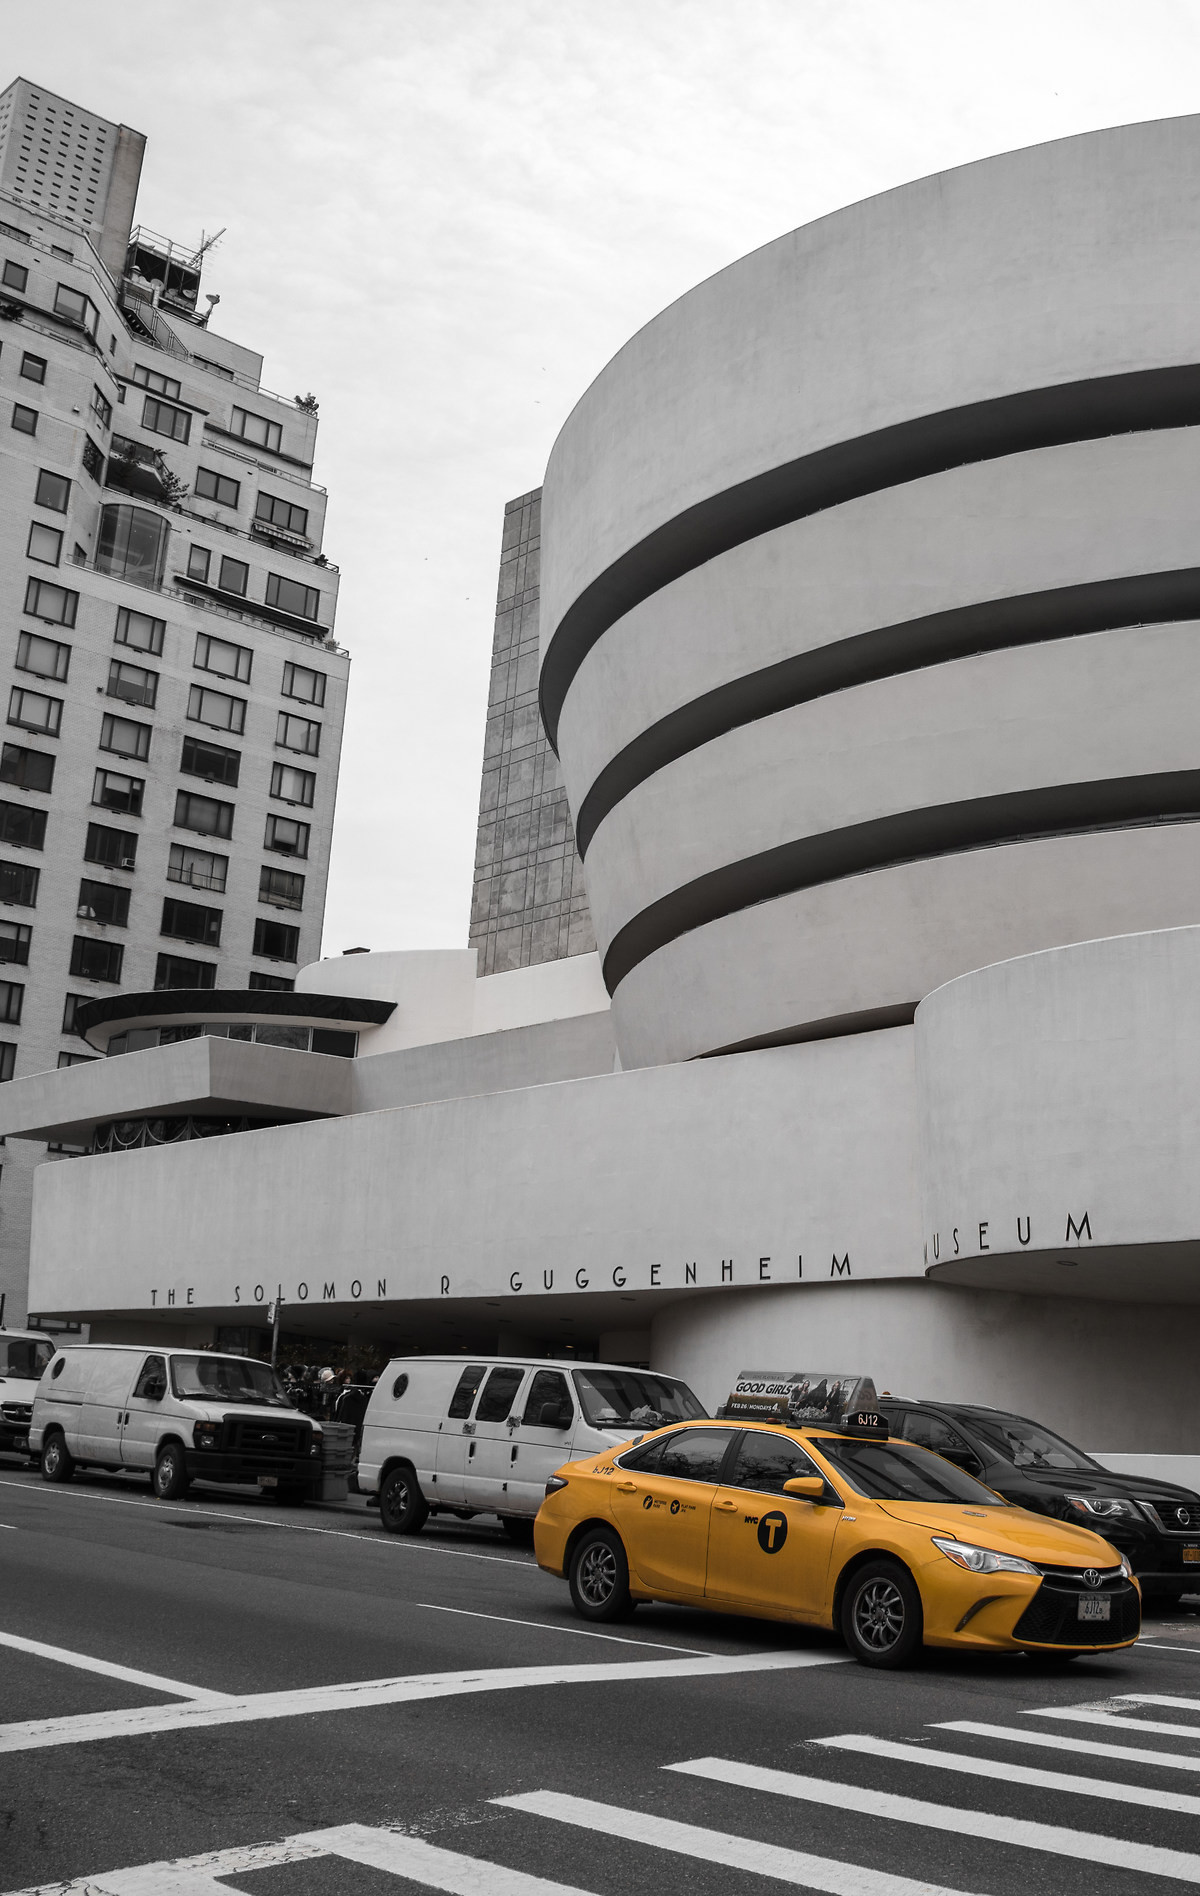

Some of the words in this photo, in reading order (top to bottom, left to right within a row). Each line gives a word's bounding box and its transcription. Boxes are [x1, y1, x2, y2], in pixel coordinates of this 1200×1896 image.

[150, 1287, 194, 1306] THE
[234, 1278, 387, 1303] SOLOMON
[440, 1275, 450, 1296] R
[509, 1253, 851, 1292] GUGGENHEIM
[736, 1382, 766, 1393] GOOD
[765, 1383, 793, 1395] GIRLS
[858, 1413, 878, 1426] 6J12
[744, 1515, 759, 1524] NYC
[765, 1518, 783, 1548] T
